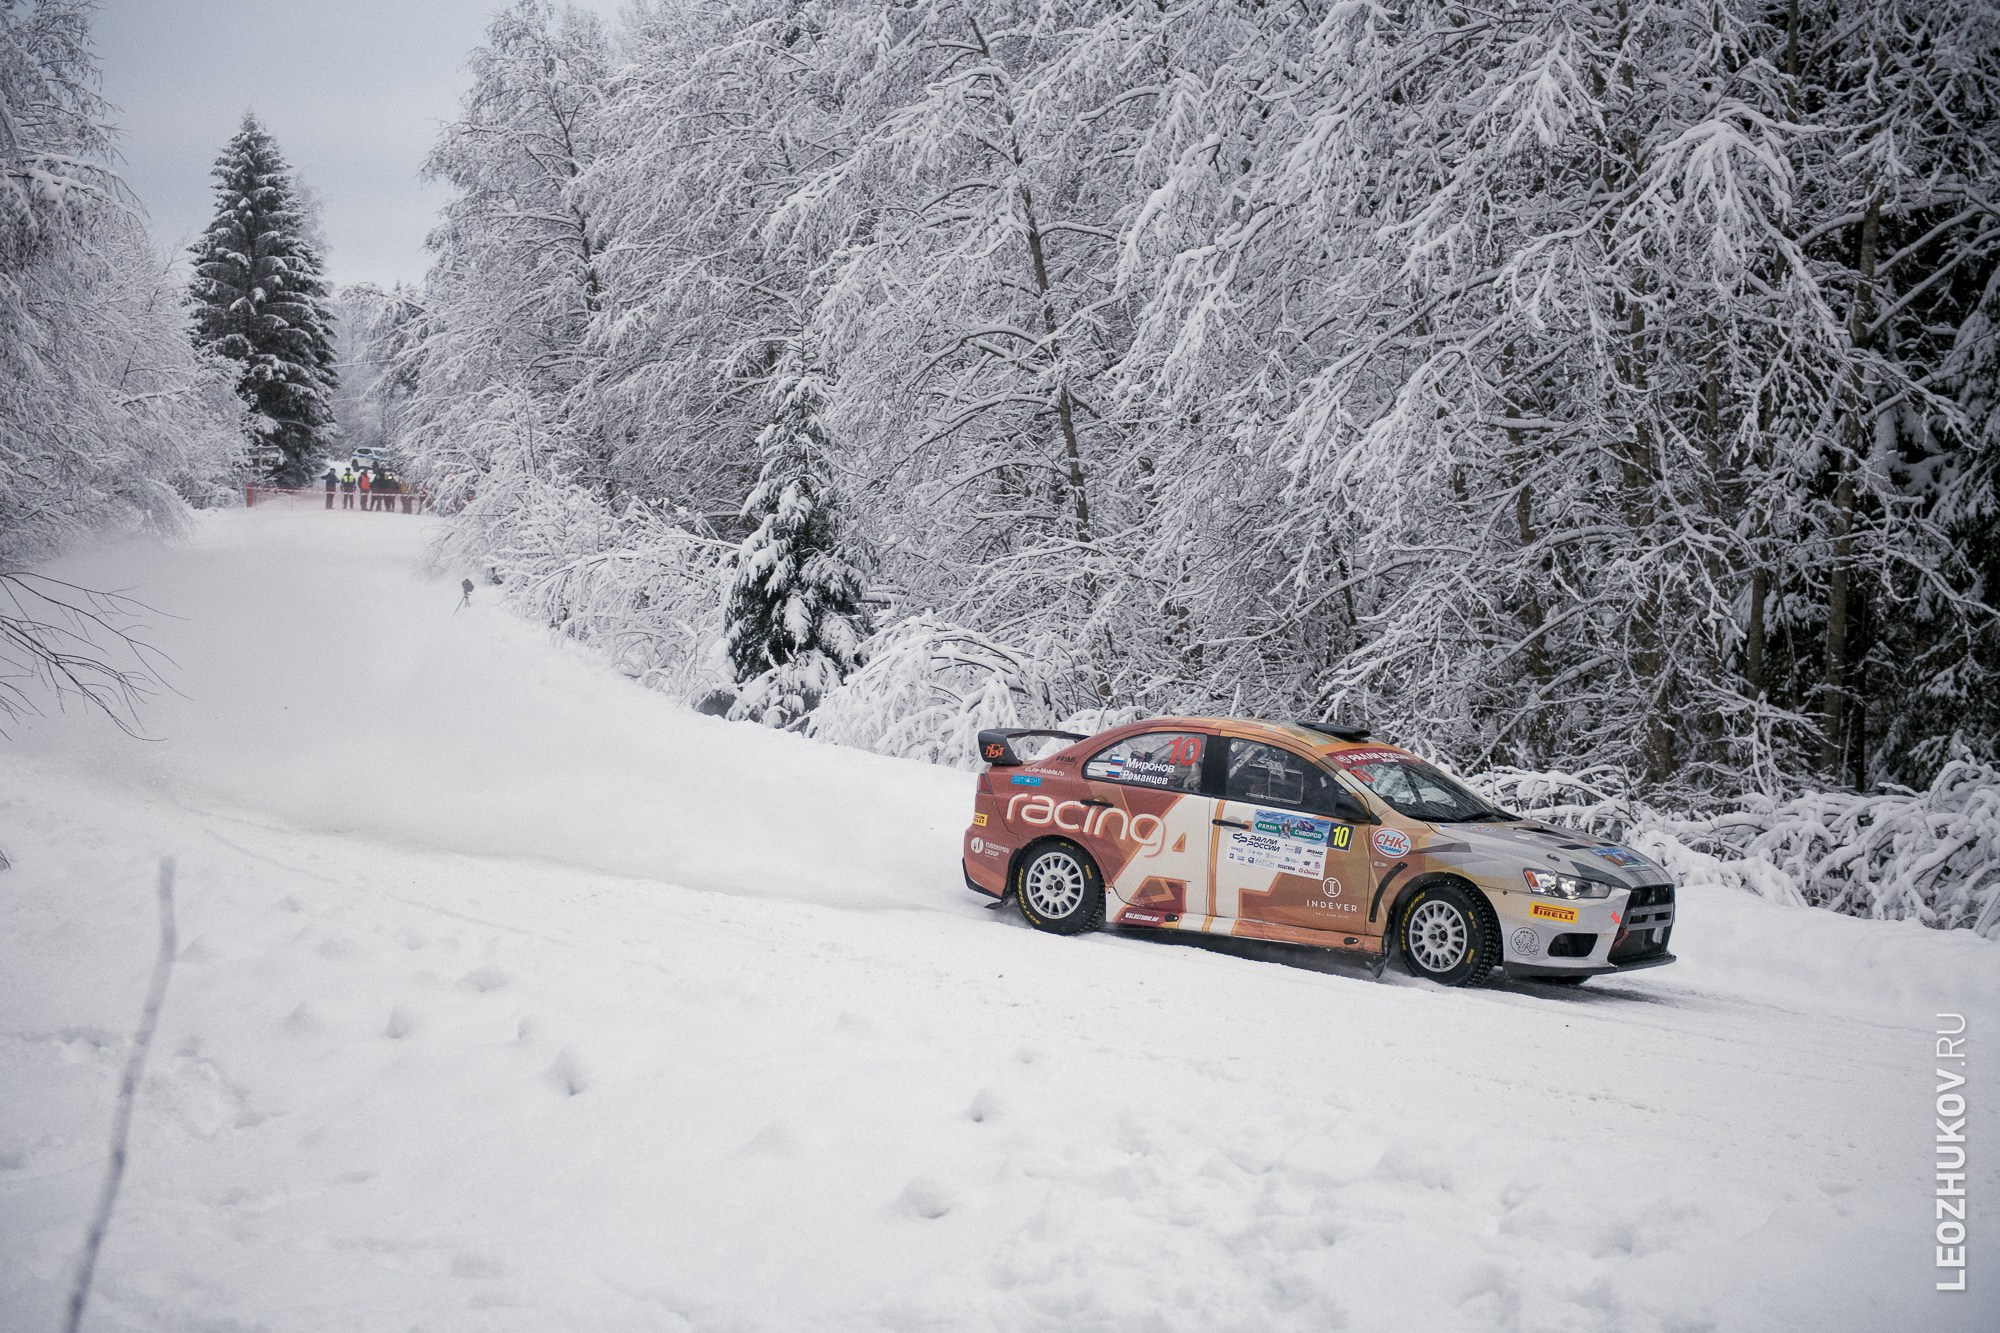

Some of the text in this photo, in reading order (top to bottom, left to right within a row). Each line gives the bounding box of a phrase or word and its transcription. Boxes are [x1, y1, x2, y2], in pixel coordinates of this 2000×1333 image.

[1168, 736, 1202, 767] 10
[1125, 758, 1175, 773] Миронов
[1122, 770, 1169, 785] Романцев
[1007, 793, 1166, 854] racing
[1333, 825, 1350, 847] 10
[1246, 842, 1280, 852] РОССИИ
[1306, 899, 1358, 912] INDEVER
[1534, 904, 1575, 921] PIRELLI
